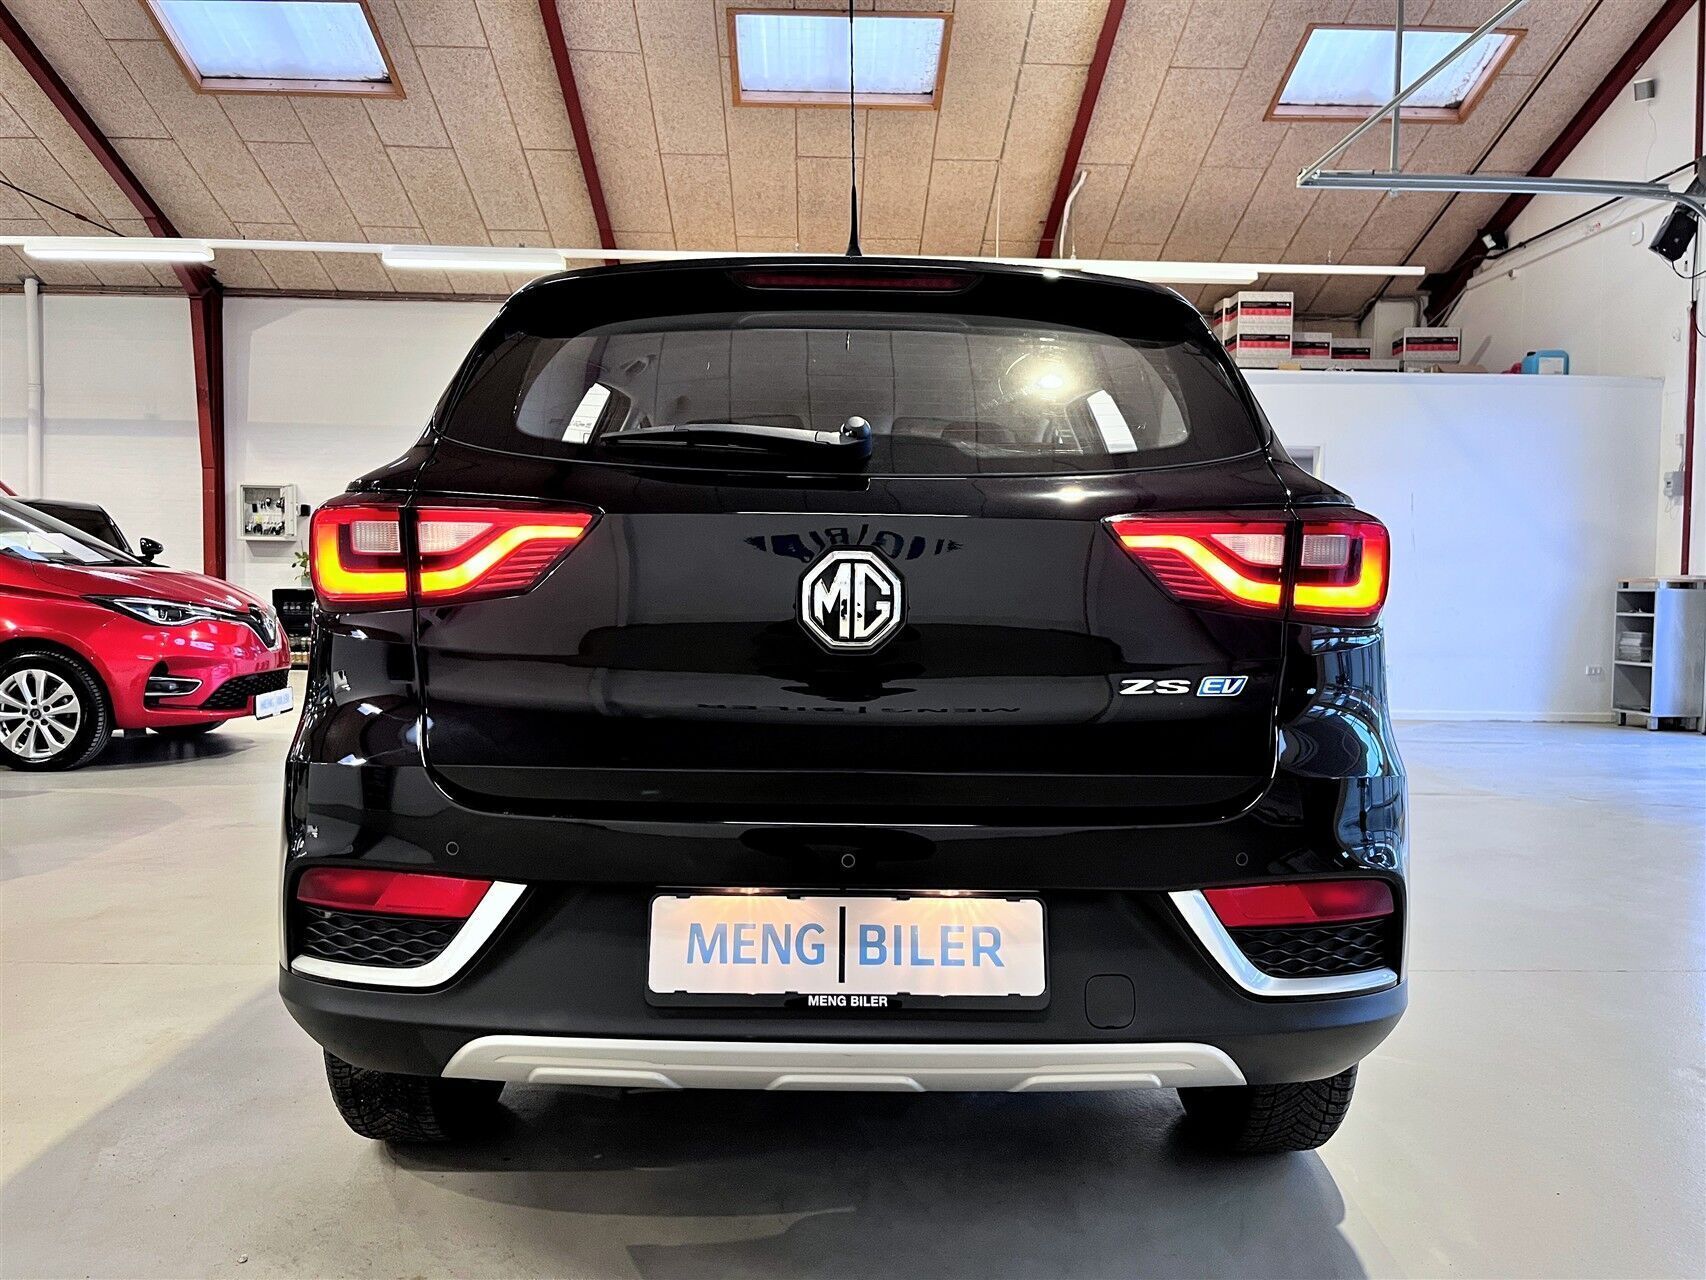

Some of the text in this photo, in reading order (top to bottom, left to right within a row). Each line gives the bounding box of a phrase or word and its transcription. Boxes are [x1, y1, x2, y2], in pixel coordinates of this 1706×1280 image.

[814, 562, 891, 639] MG
[1119, 678, 1244, 695] ZS EV
[686, 922, 1005, 968] MENG BILER
[807, 995, 889, 1008] MENG BILER
